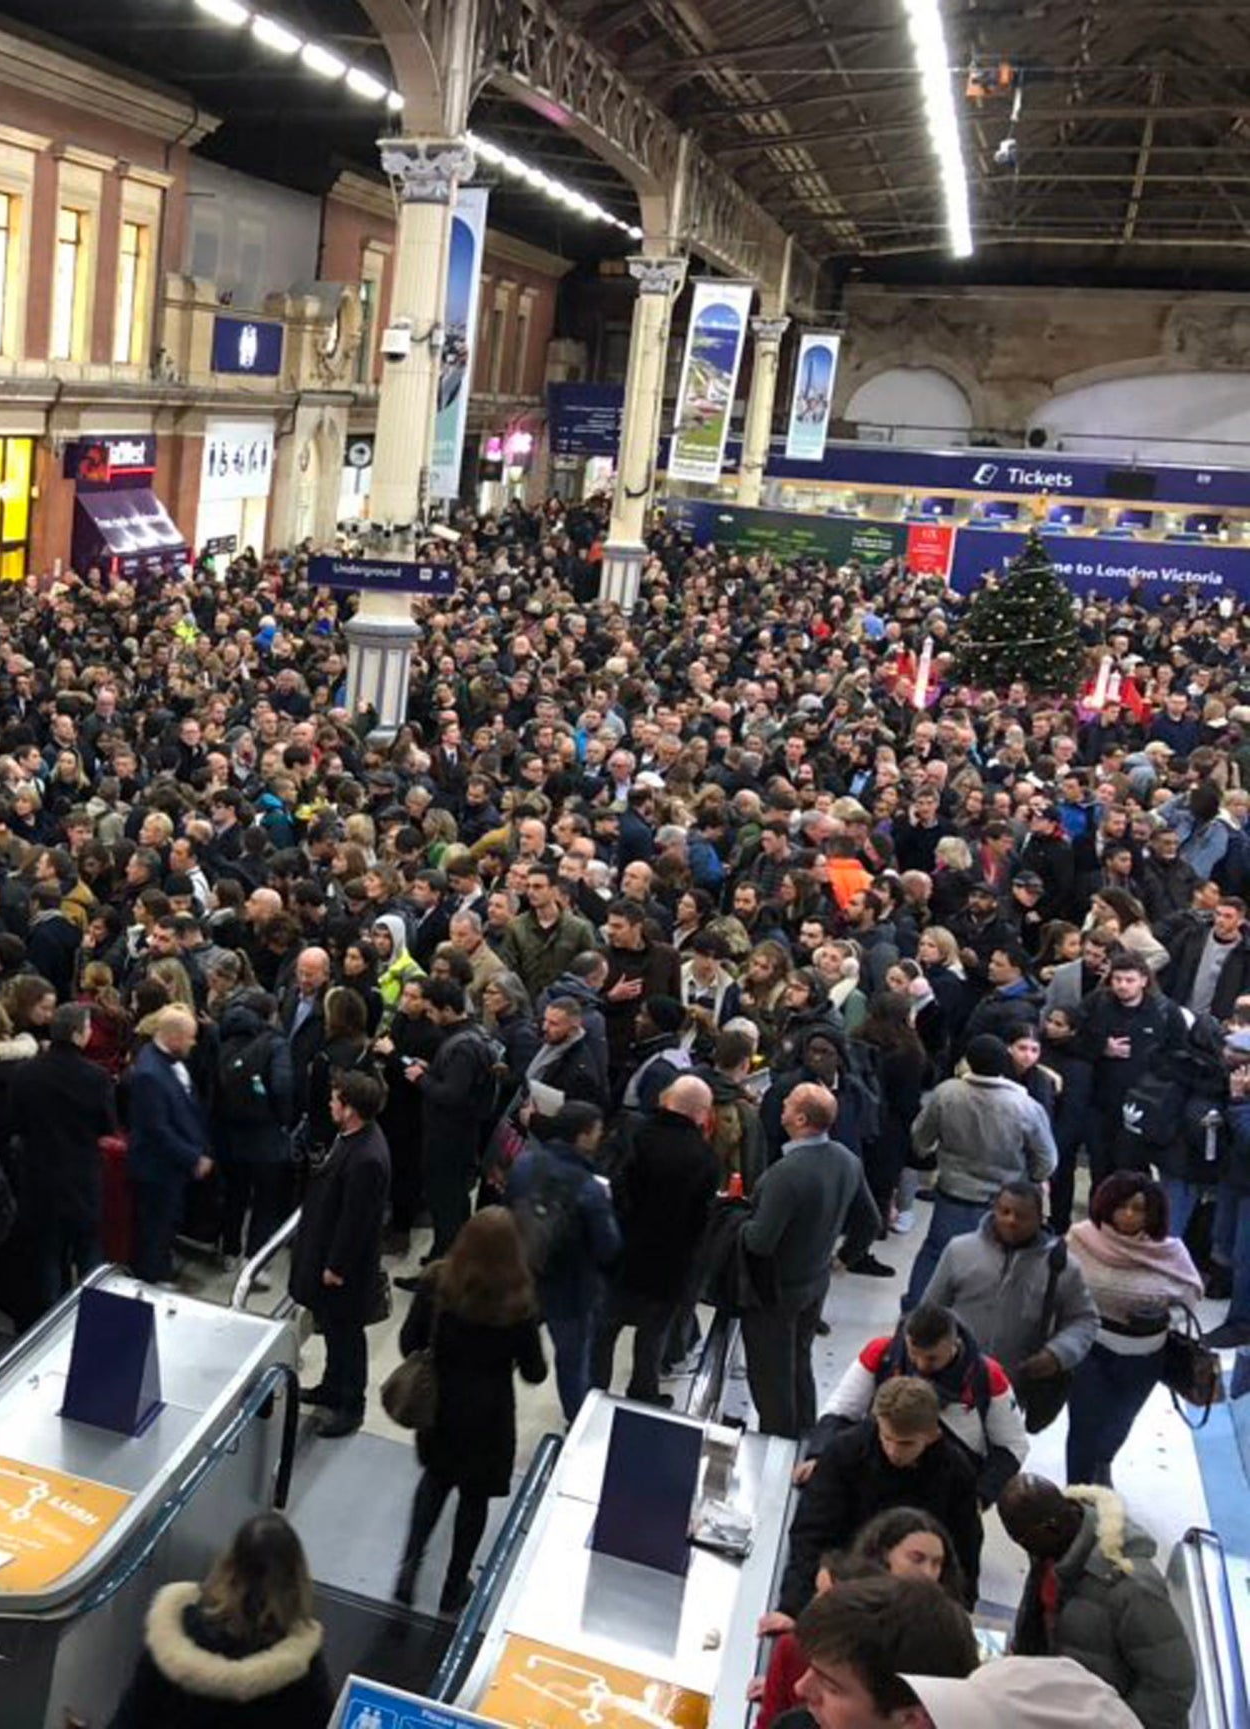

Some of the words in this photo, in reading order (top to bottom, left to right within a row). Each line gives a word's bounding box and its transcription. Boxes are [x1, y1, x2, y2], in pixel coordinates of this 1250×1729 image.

[1007, 467, 1074, 488] Tickets
[332, 562, 402, 577] Underground
[1076, 563, 1093, 576] to
[1096, 563, 1158, 580] London
[1160, 567, 1224, 585] Victoria
